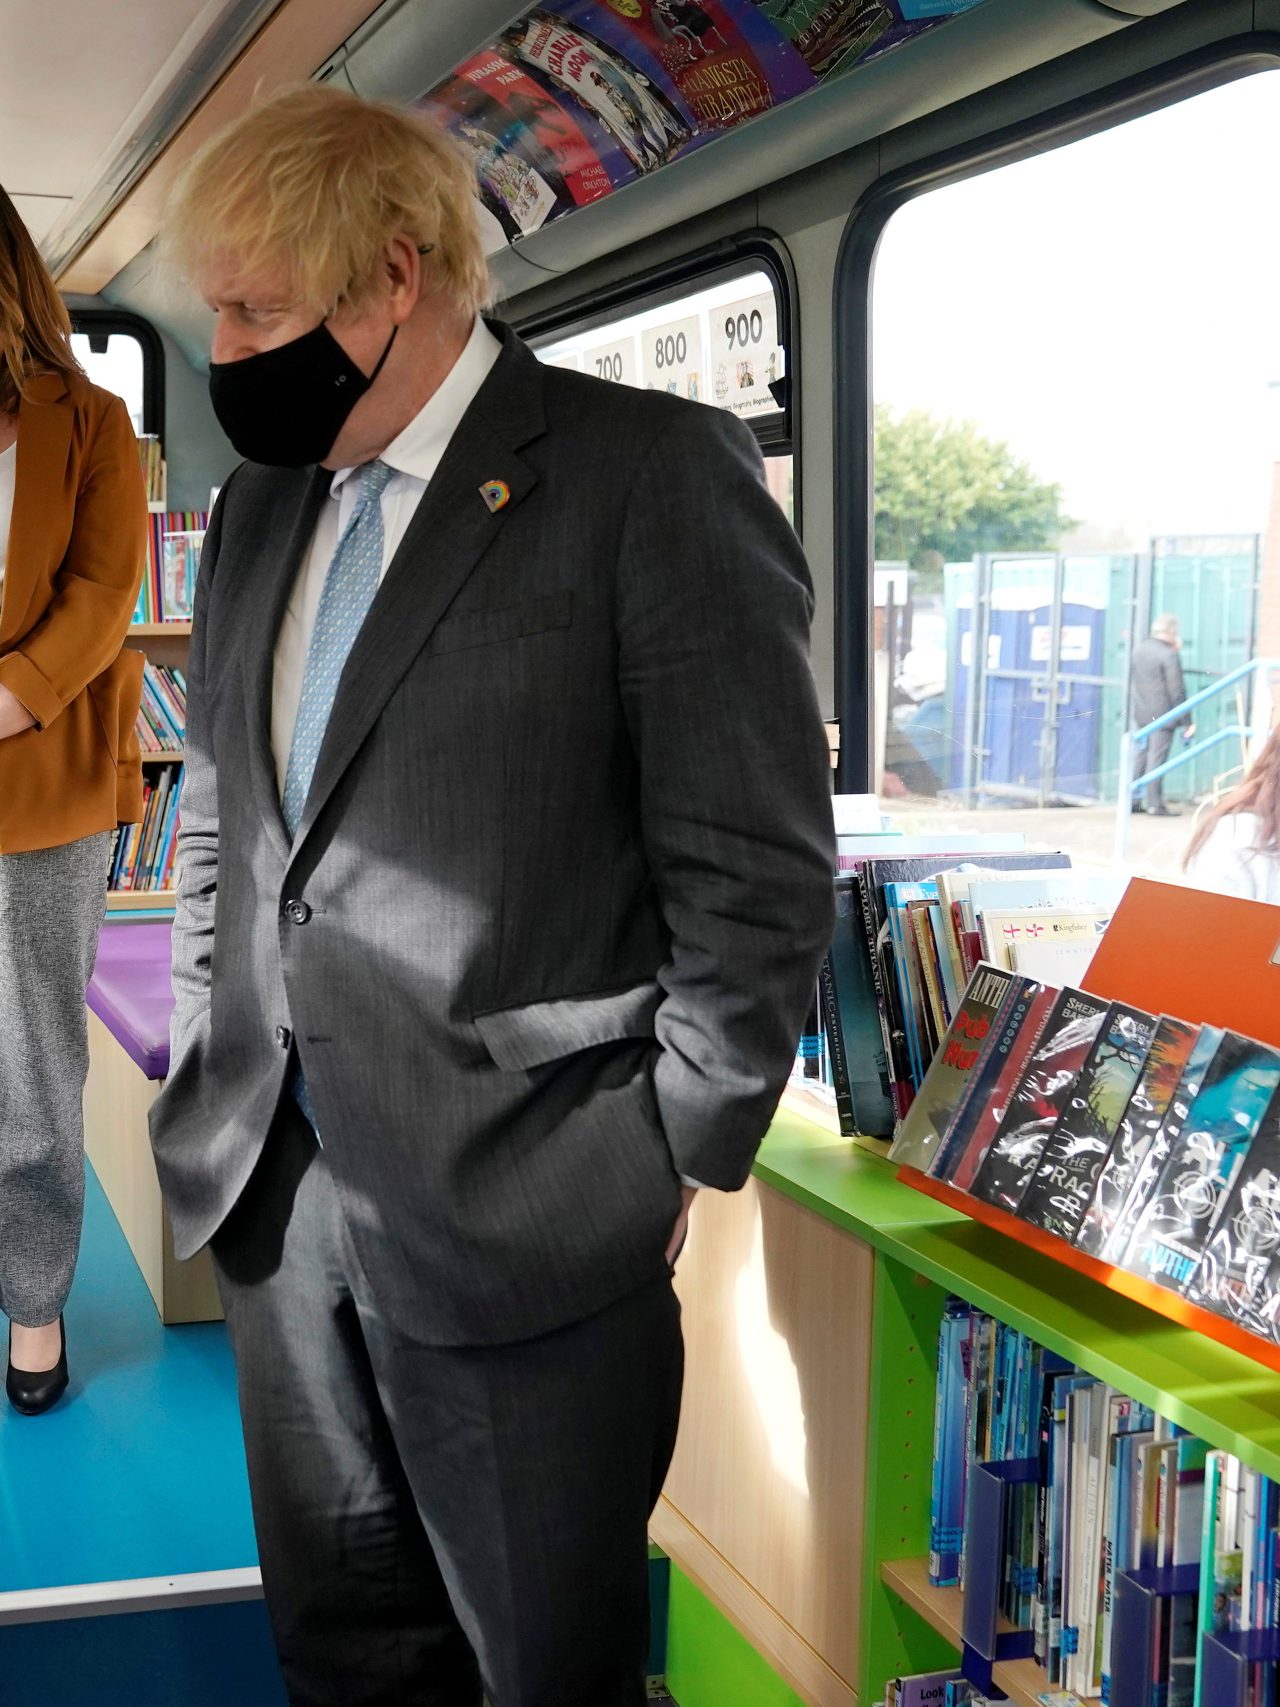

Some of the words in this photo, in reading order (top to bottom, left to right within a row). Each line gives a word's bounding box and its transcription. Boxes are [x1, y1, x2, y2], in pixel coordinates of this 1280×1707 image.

[466, 58, 510, 82] JURASSIC
[548, 33, 583, 76] CHARLIE
[568, 49, 593, 82] MOON
[496, 69, 526, 86] PARK
[683, 58, 757, 92] GANGSTA
[697, 81, 763, 120] GRANNY
[580, 166, 606, 177] MICHAEL
[582, 178, 611, 191] CRICHTON
[725, 309, 763, 351] 900
[655, 331, 687, 370] 800
[595, 352, 623, 383] 700
[856, 871, 872, 934] EXPLORE
[867, 936, 882, 996] TITANIC
[1058, 922, 1088, 935] Kingfisher
[827, 1012, 845, 1072] EXPERIENCE
[920, 1685, 945, 1700] Look
